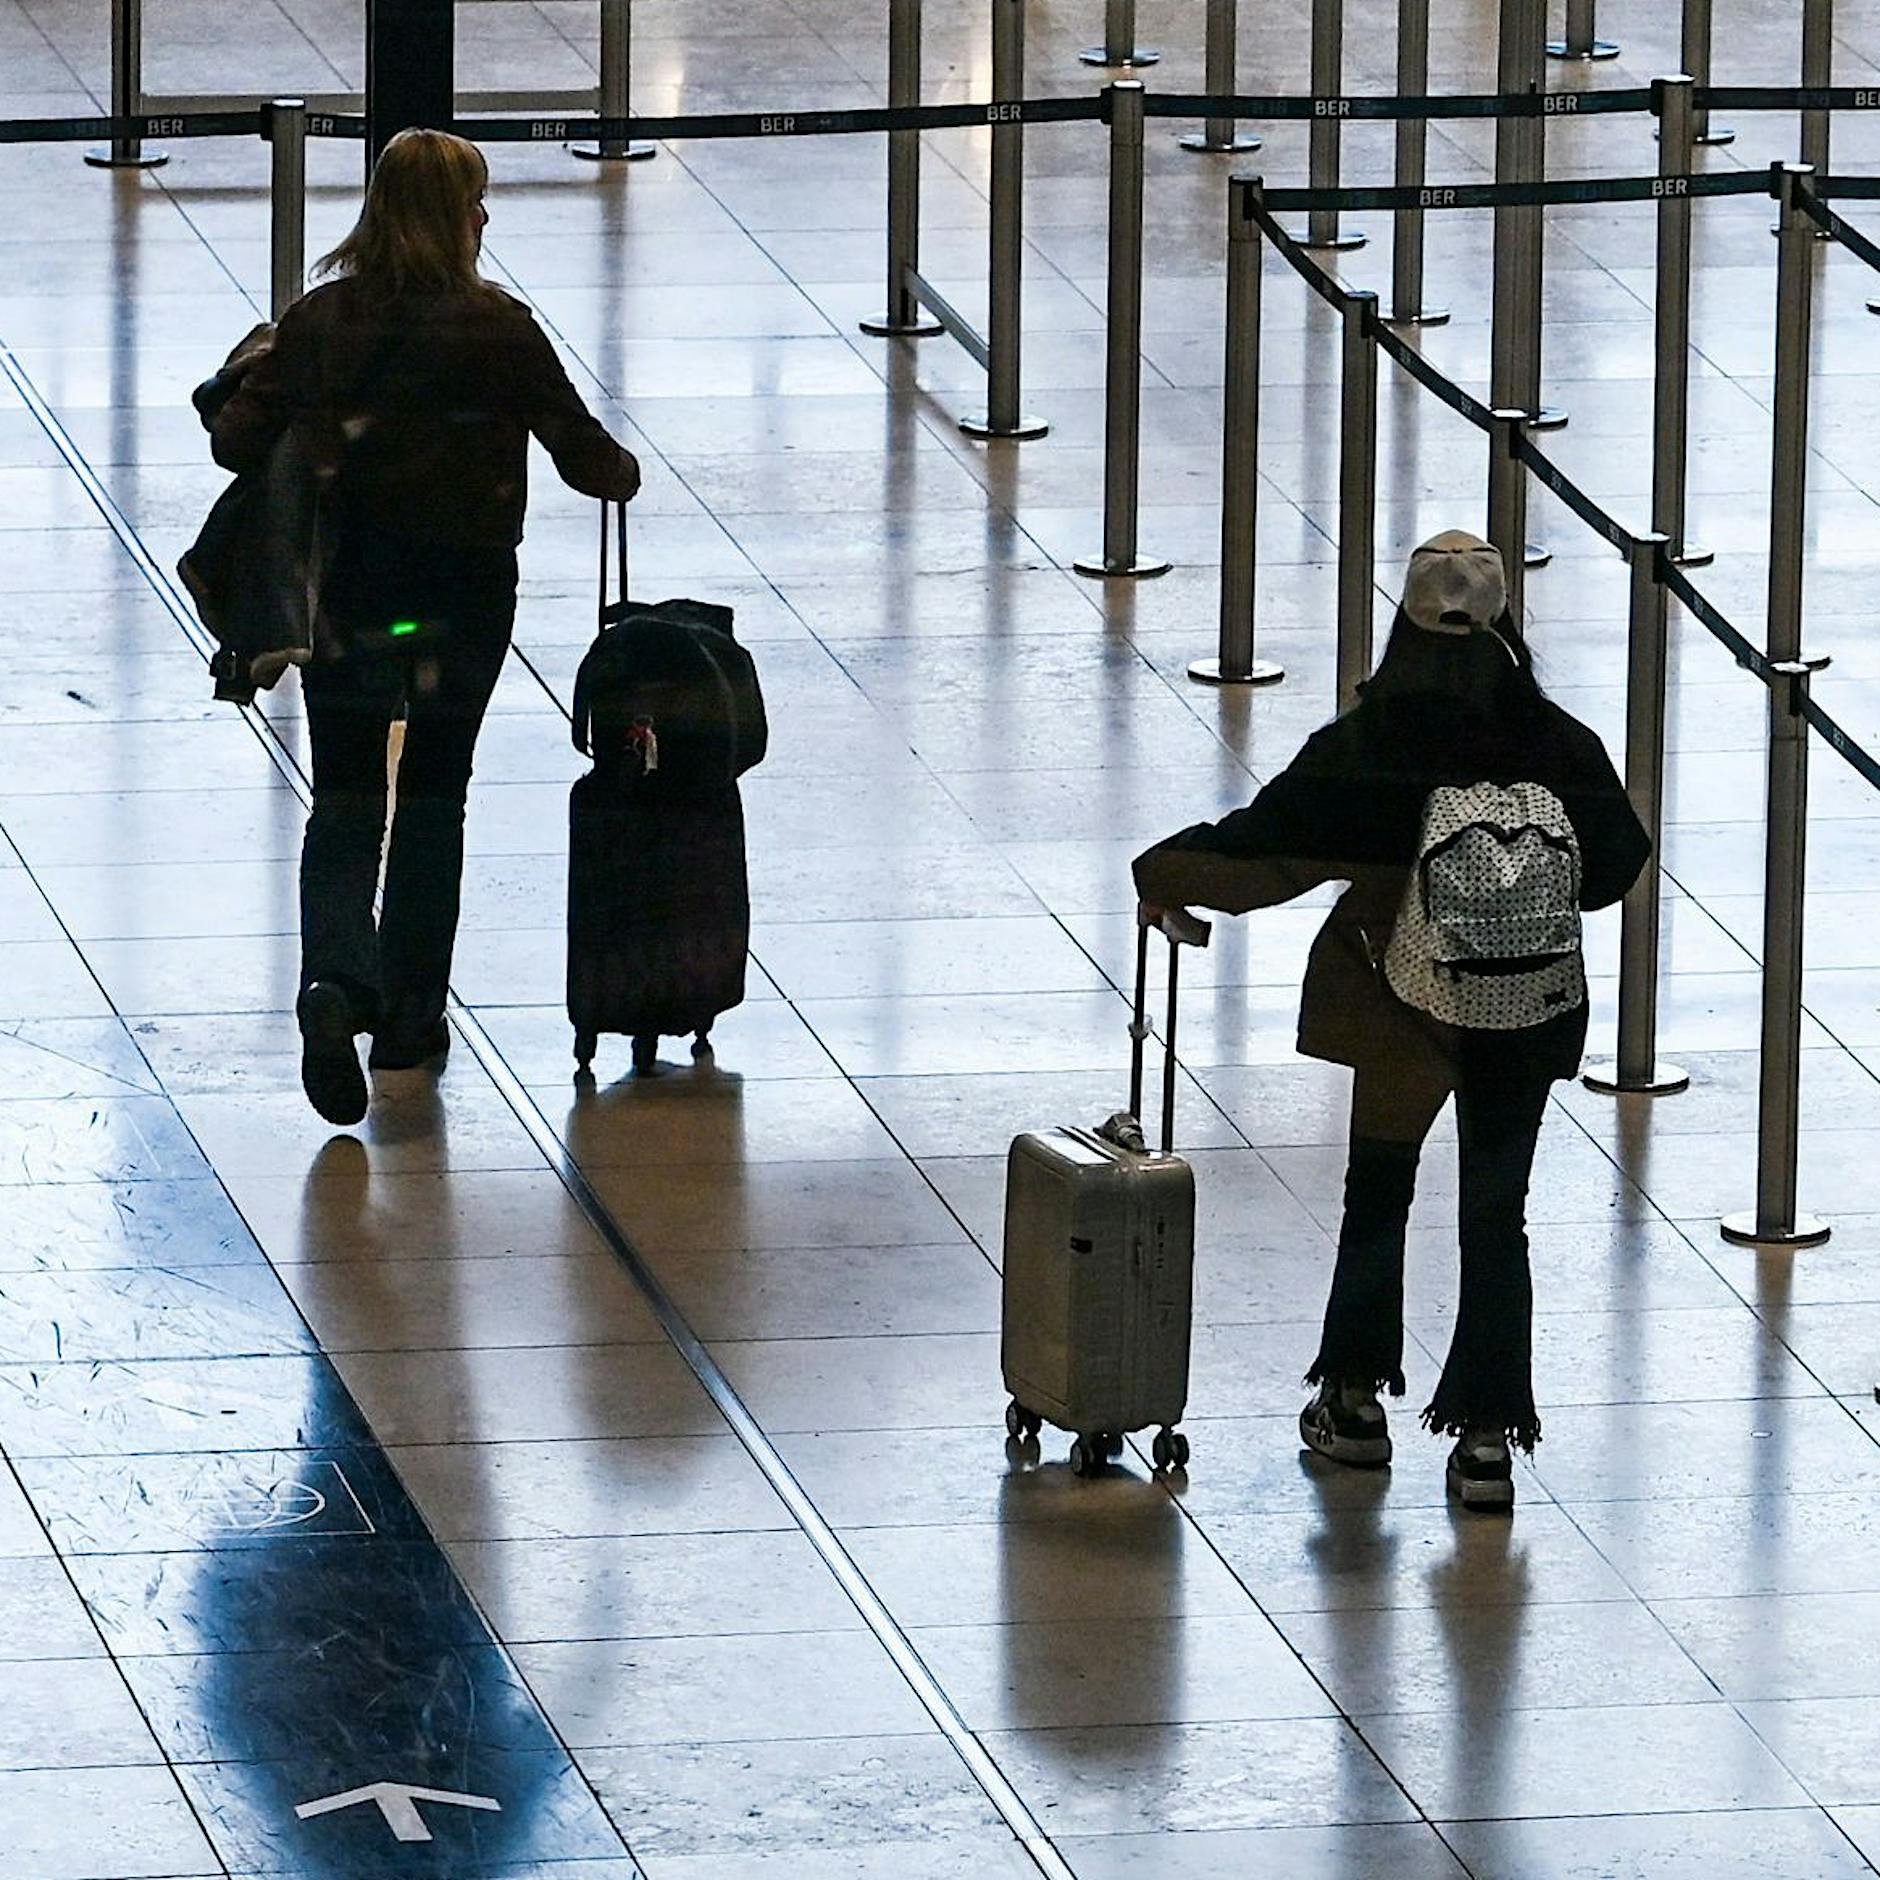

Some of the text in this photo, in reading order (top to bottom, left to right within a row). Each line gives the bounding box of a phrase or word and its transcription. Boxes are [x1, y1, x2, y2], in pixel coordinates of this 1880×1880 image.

[1544, 95, 1577, 112] BER
[1854, 90, 1880, 107] BE
[986, 104, 1022, 122] BER
[1314, 100, 1350, 117] BER
[147, 118, 184, 135] BER
[531, 121, 567, 138] BER
[760, 116, 796, 133] BER
[1651, 178, 1688, 197] BER
[1419, 189, 1456, 207] BER
